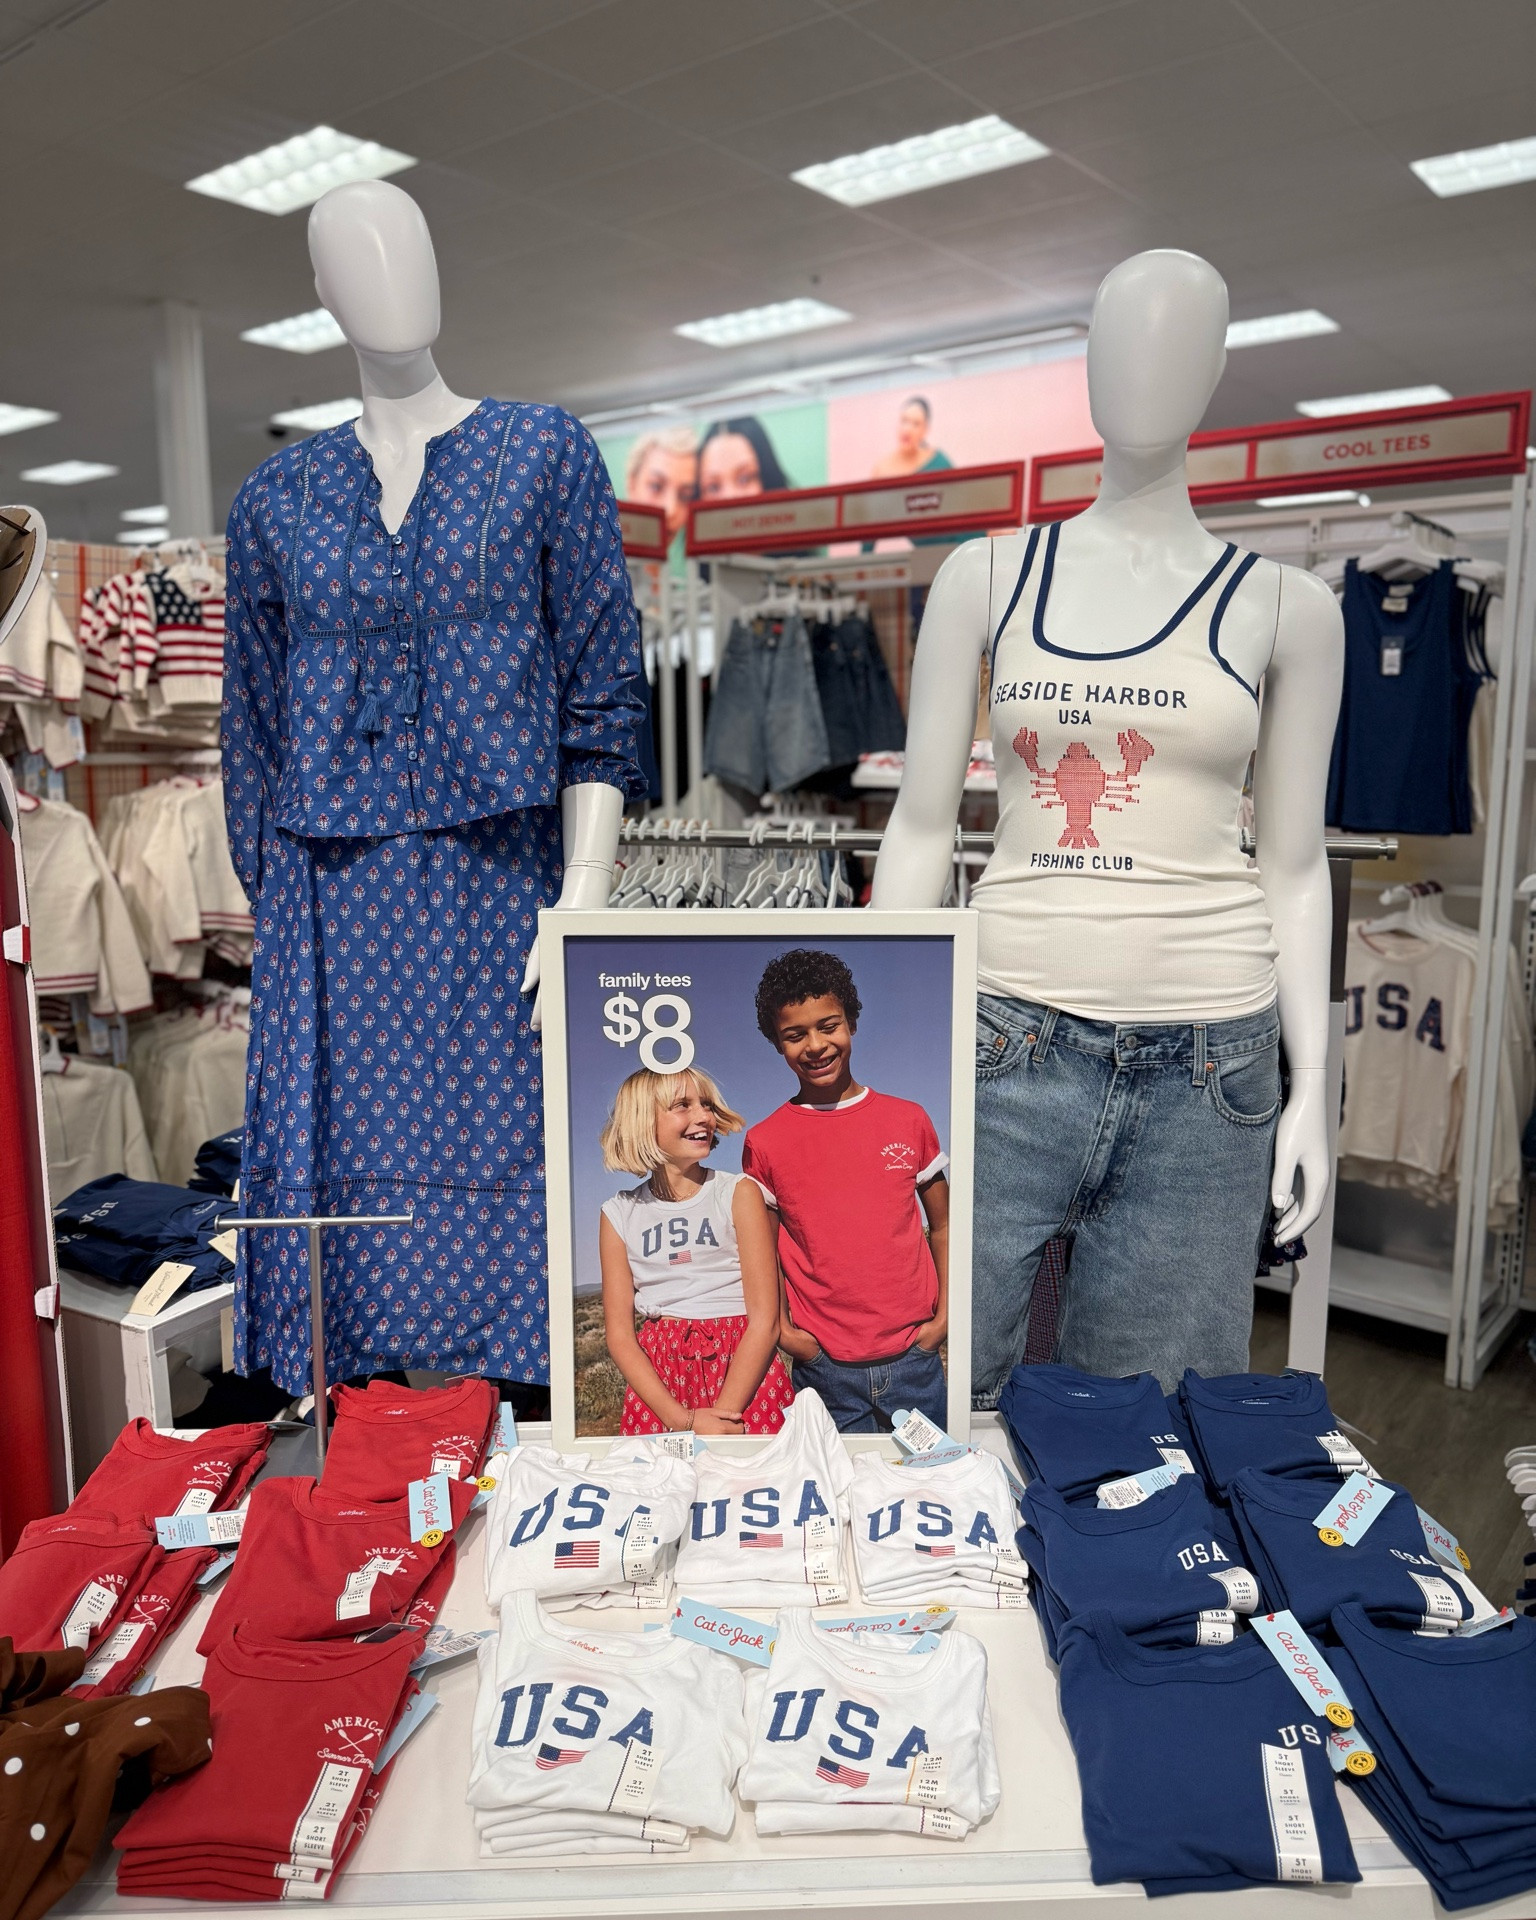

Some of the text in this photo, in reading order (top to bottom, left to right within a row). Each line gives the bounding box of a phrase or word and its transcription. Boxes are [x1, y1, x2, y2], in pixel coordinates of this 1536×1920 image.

[1323, 434, 1431, 460] COOL TEES
[994, 681, 1187, 708] SEASIDE HARBOR
[1059, 709, 1092, 725] USA
[1030, 853, 1133, 870] FISHING CLUB
[599, 972, 692, 991] family tees
[1344, 982, 1446, 1053] USA
[602, 991, 695, 1075] $8
[880, 1143, 916, 1157] AMERICAN
[641, 1217, 720, 1258] USA
[1150, 1433, 1179, 1444] US
[418, 1485, 440, 1529] Cat & Jack
[690, 1479, 836, 1542] USA
[1333, 1488, 1373, 1531] Cat & Jack
[867, 1499, 998, 1549] USA
[1432, 1528, 1453, 1550] Jack
[1177, 1540, 1230, 1571] USA
[1389, 1548, 1441, 1567] USA
[693, 1615, 765, 1650] Cat & Jack
[869, 1622, 892, 1632] Cat
[1276, 1631, 1333, 1699] Cat & Jack
[494, 1682, 654, 1749] USA
[766, 1688, 929, 1769] USA
[1278, 1723, 1322, 1748] US
[317, 1747, 352, 1763] Summer
[636, 1754, 654, 1763] SHORT
[642, 1749, 653, 1757] 2T
[1278, 1753, 1289, 1761] 5T
[634, 1759, 653, 1768] SLEEVE
[917, 1792, 937, 1800] SLEEVE
[918, 1784, 937, 1792] SHORT
[931, 1821, 951, 1830] SLEEVE
[932, 1814, 952, 1822] SHORT
[306, 1834, 327, 1842] SHORT
[313, 1826, 325, 1834] 2T
[304, 1842, 325, 1851] SLEEVE
[1295, 1858, 1307, 1866] 5T
[291, 1868, 304, 1877] 2T
